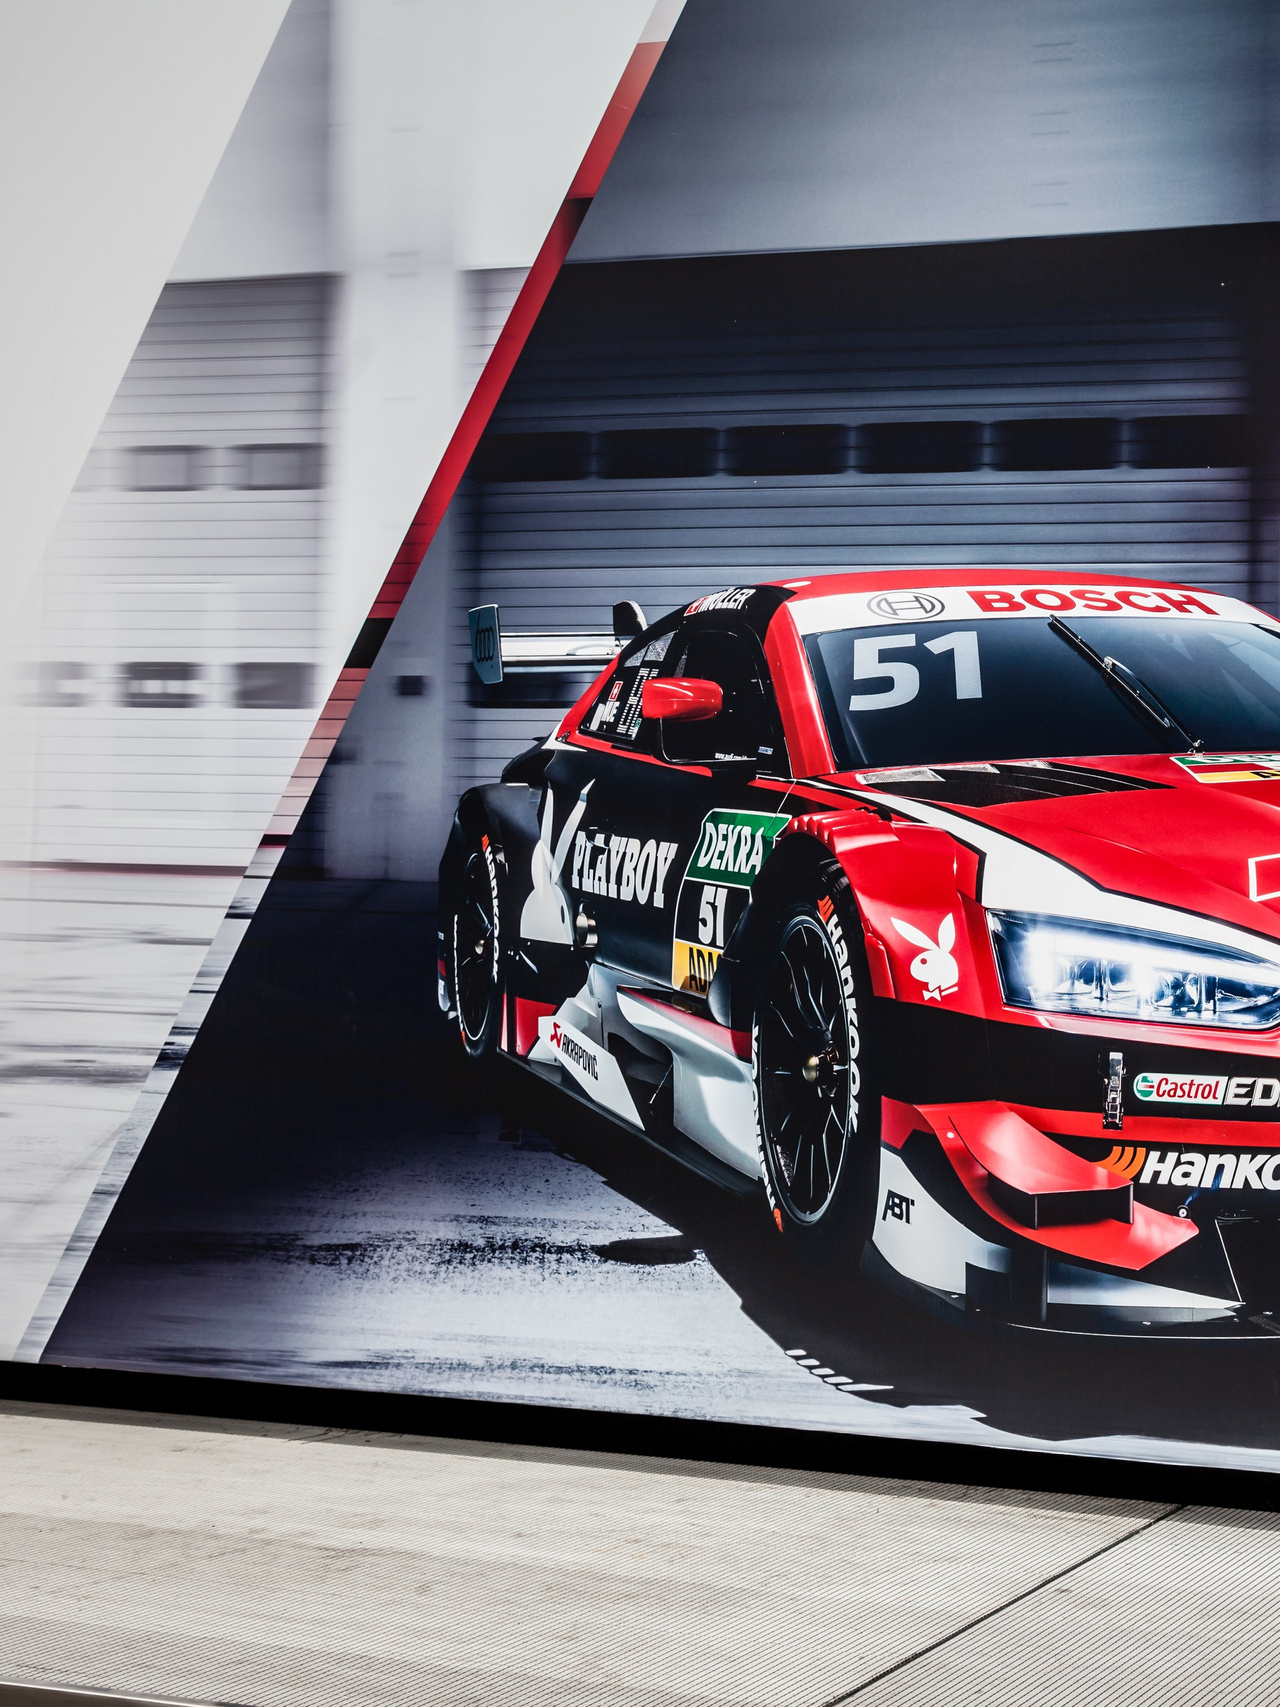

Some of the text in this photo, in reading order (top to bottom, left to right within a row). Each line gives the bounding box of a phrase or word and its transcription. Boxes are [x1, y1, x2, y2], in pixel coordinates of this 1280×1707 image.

[966, 587, 1220, 615] BOSCH
[849, 631, 982, 711] 51
[571, 830, 678, 909] PLAYBOY
[697, 821, 765, 876] DEKRA
[698, 886, 727, 947] 51
[1154, 1077, 1222, 1102] Castrol
[882, 1188, 915, 1225] ABT
